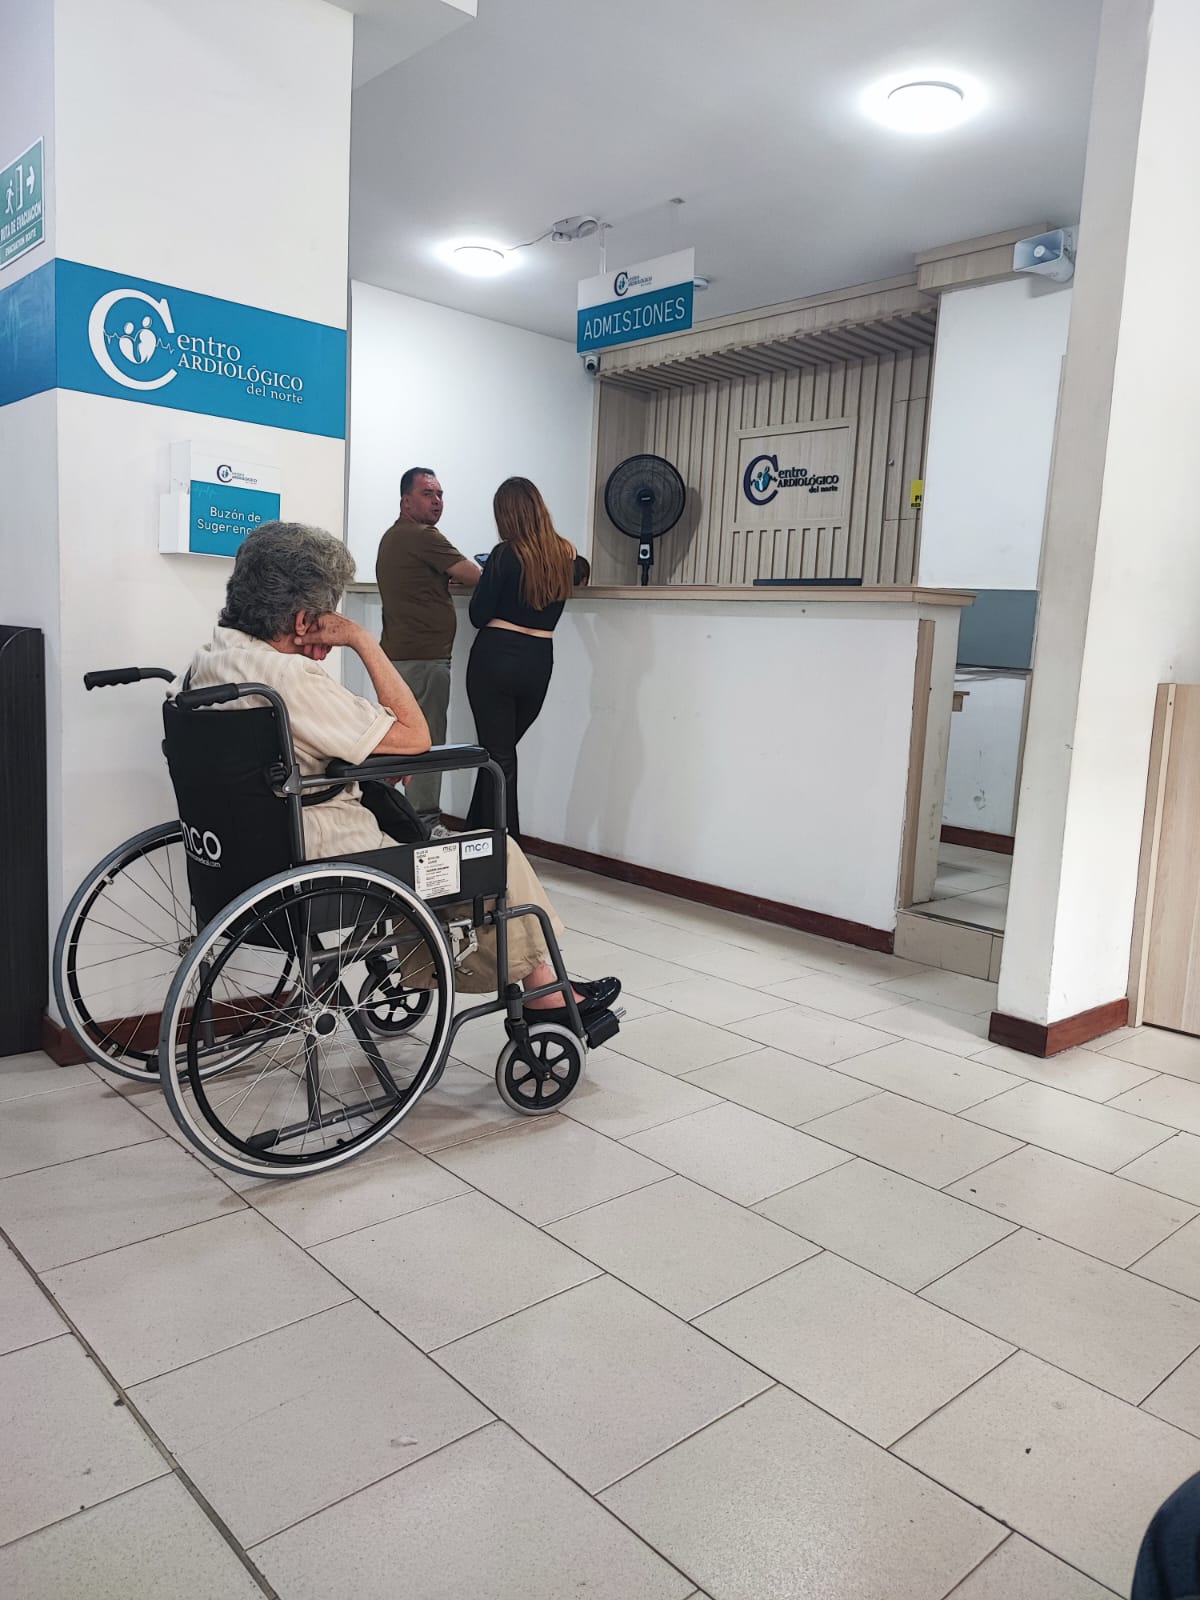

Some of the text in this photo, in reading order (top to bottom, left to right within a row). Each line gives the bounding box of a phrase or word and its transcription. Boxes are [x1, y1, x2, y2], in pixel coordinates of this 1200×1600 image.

[583, 297, 685, 341] ADMISIONES
[246, 383, 303, 405] del norte
[210, 506, 261, 523] Buzón de
[197, 518, 259, 536] Sugerenc
